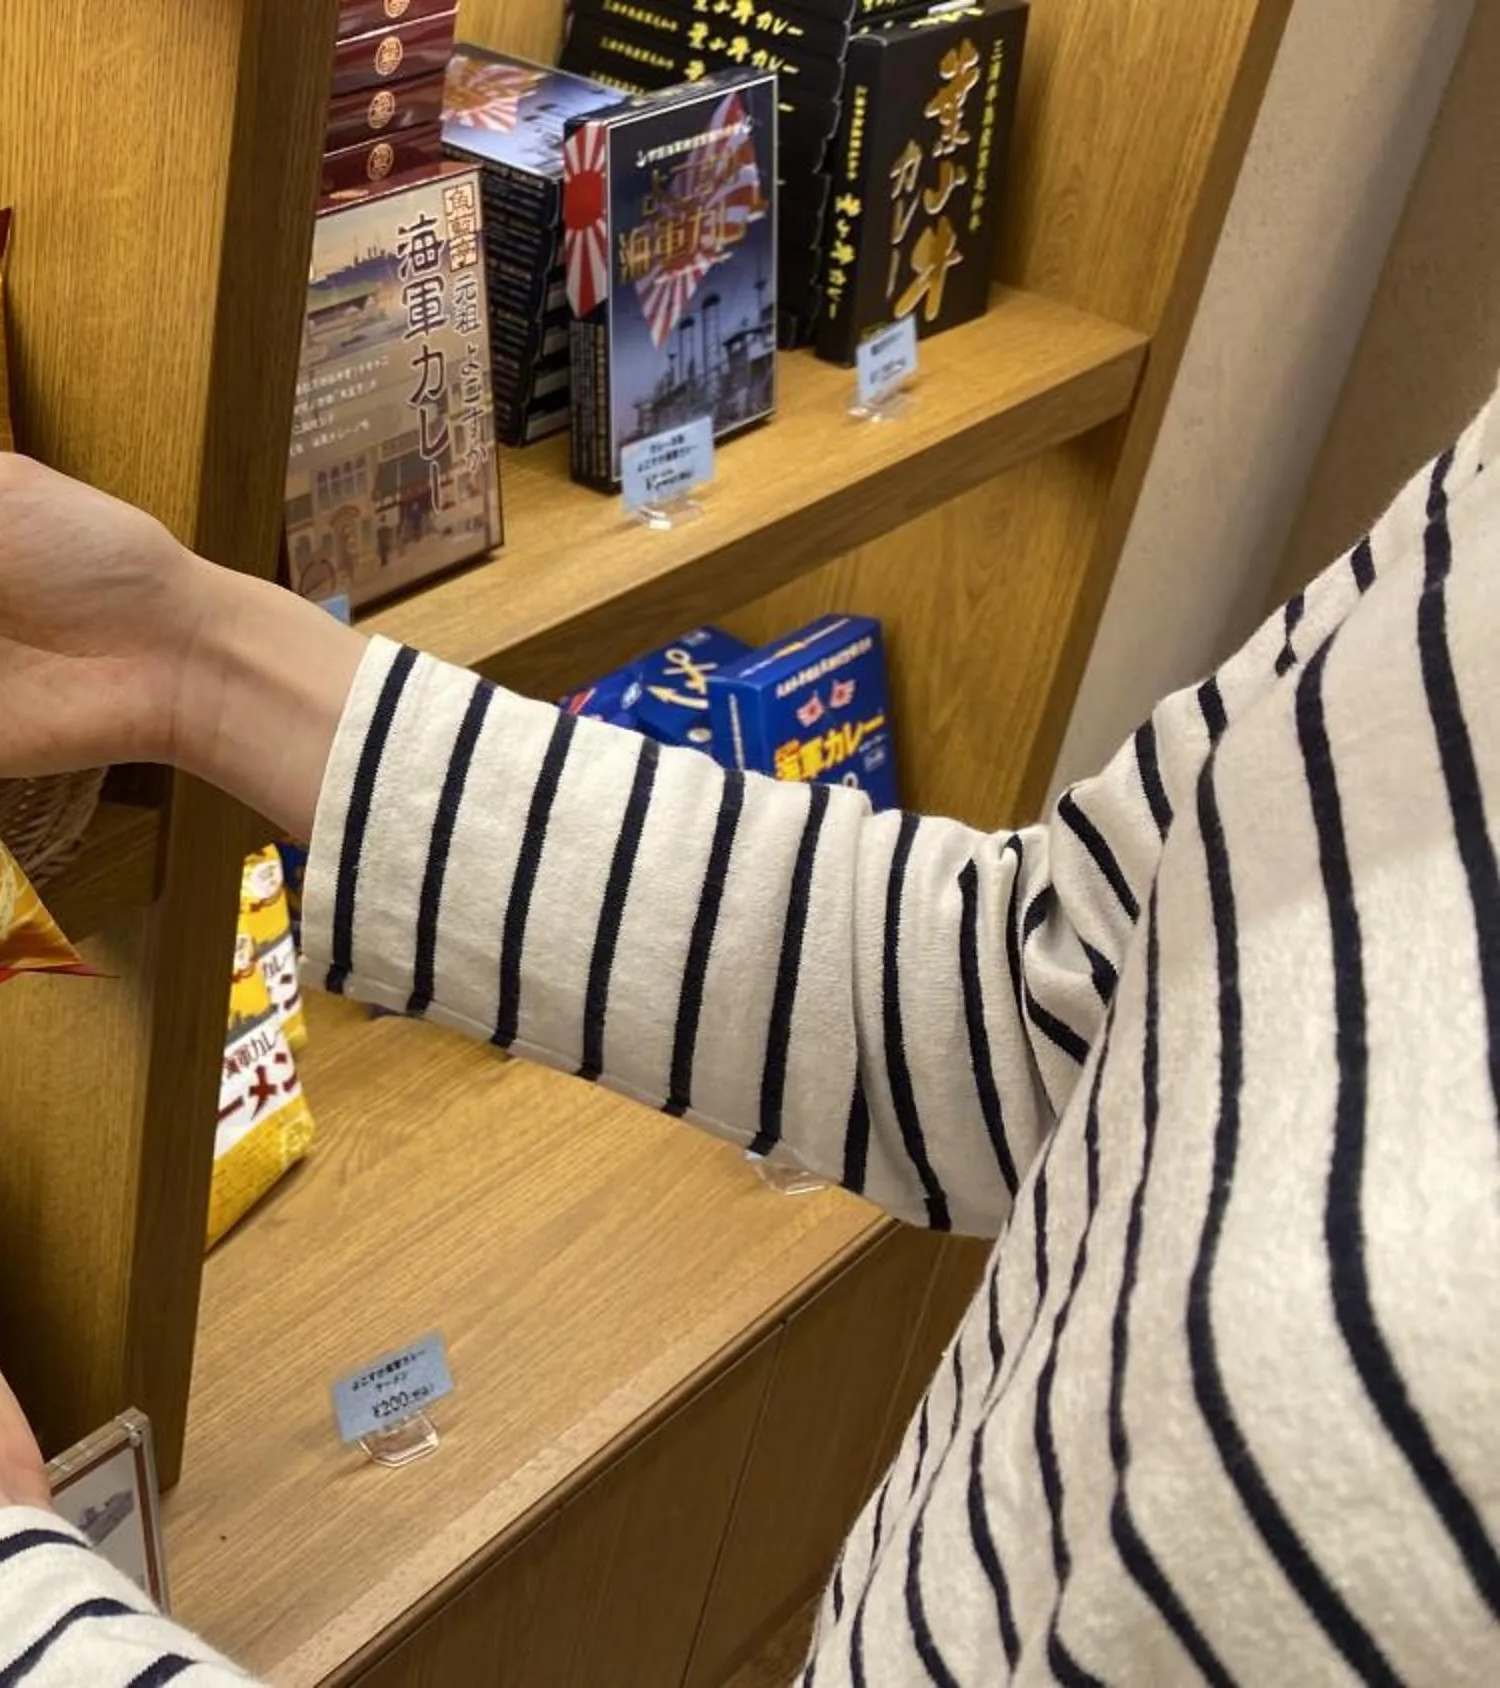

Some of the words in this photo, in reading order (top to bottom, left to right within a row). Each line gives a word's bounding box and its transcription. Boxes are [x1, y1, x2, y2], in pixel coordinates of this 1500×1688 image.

[397, 213, 451, 514] 海軍カレー
[452, 272, 482, 336] 元祖
[460, 341, 489, 477] よこすか
